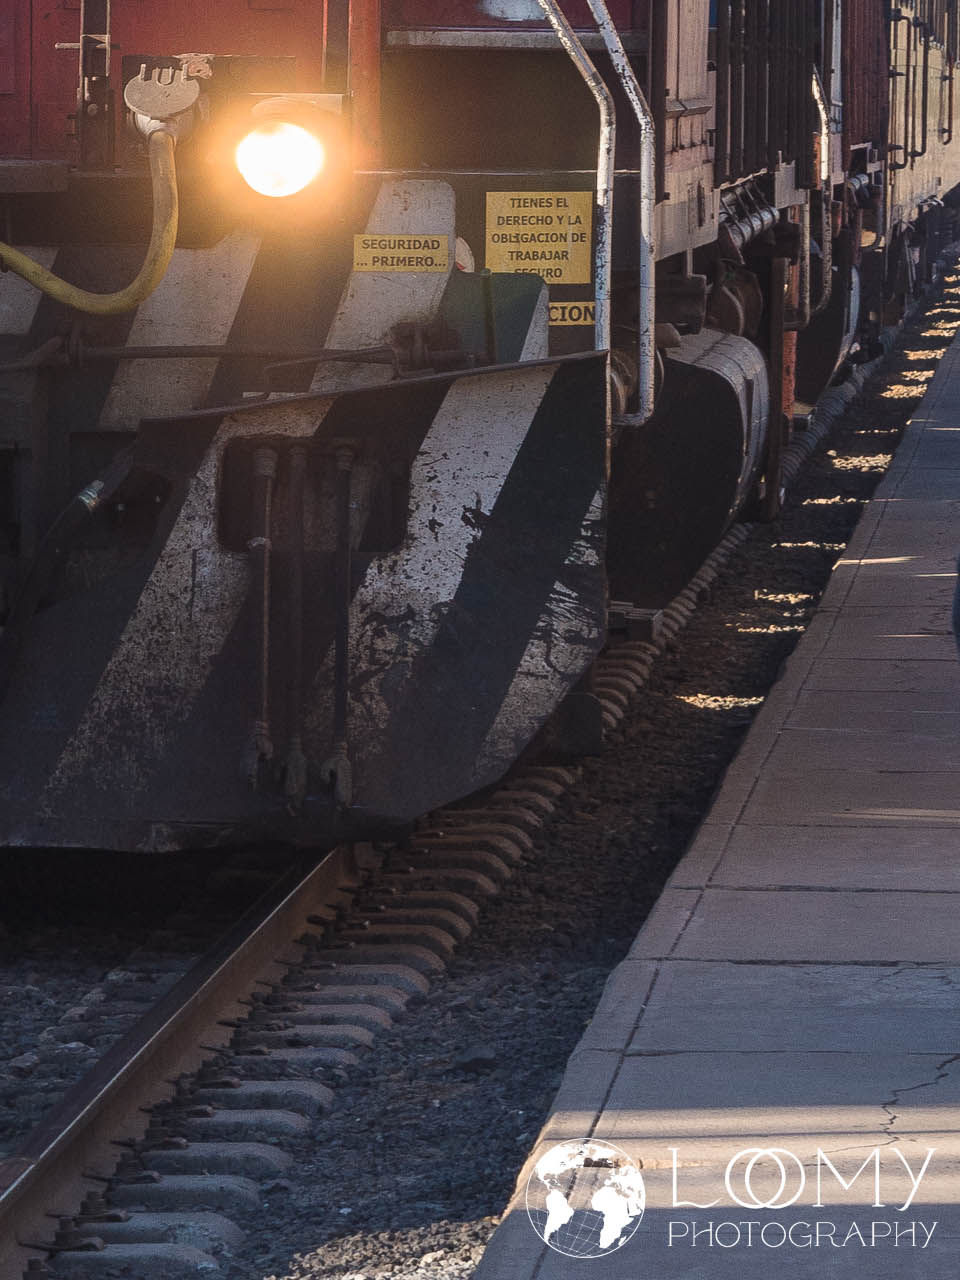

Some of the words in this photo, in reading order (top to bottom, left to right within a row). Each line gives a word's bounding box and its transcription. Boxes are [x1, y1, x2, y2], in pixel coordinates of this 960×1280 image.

[510, 198, 552, 209] TIENES
[556, 198, 569, 209] EL
[496, 215, 553, 226] DERECHO
[556, 216, 565, 226] Y
[568, 216, 582, 226] LA
[491, 232, 568, 243] OBLIGACION
[571, 232, 587, 243] DE
[361, 239, 441, 250] SEGURIDAD
[508, 250, 569, 261] TRABAJAR
